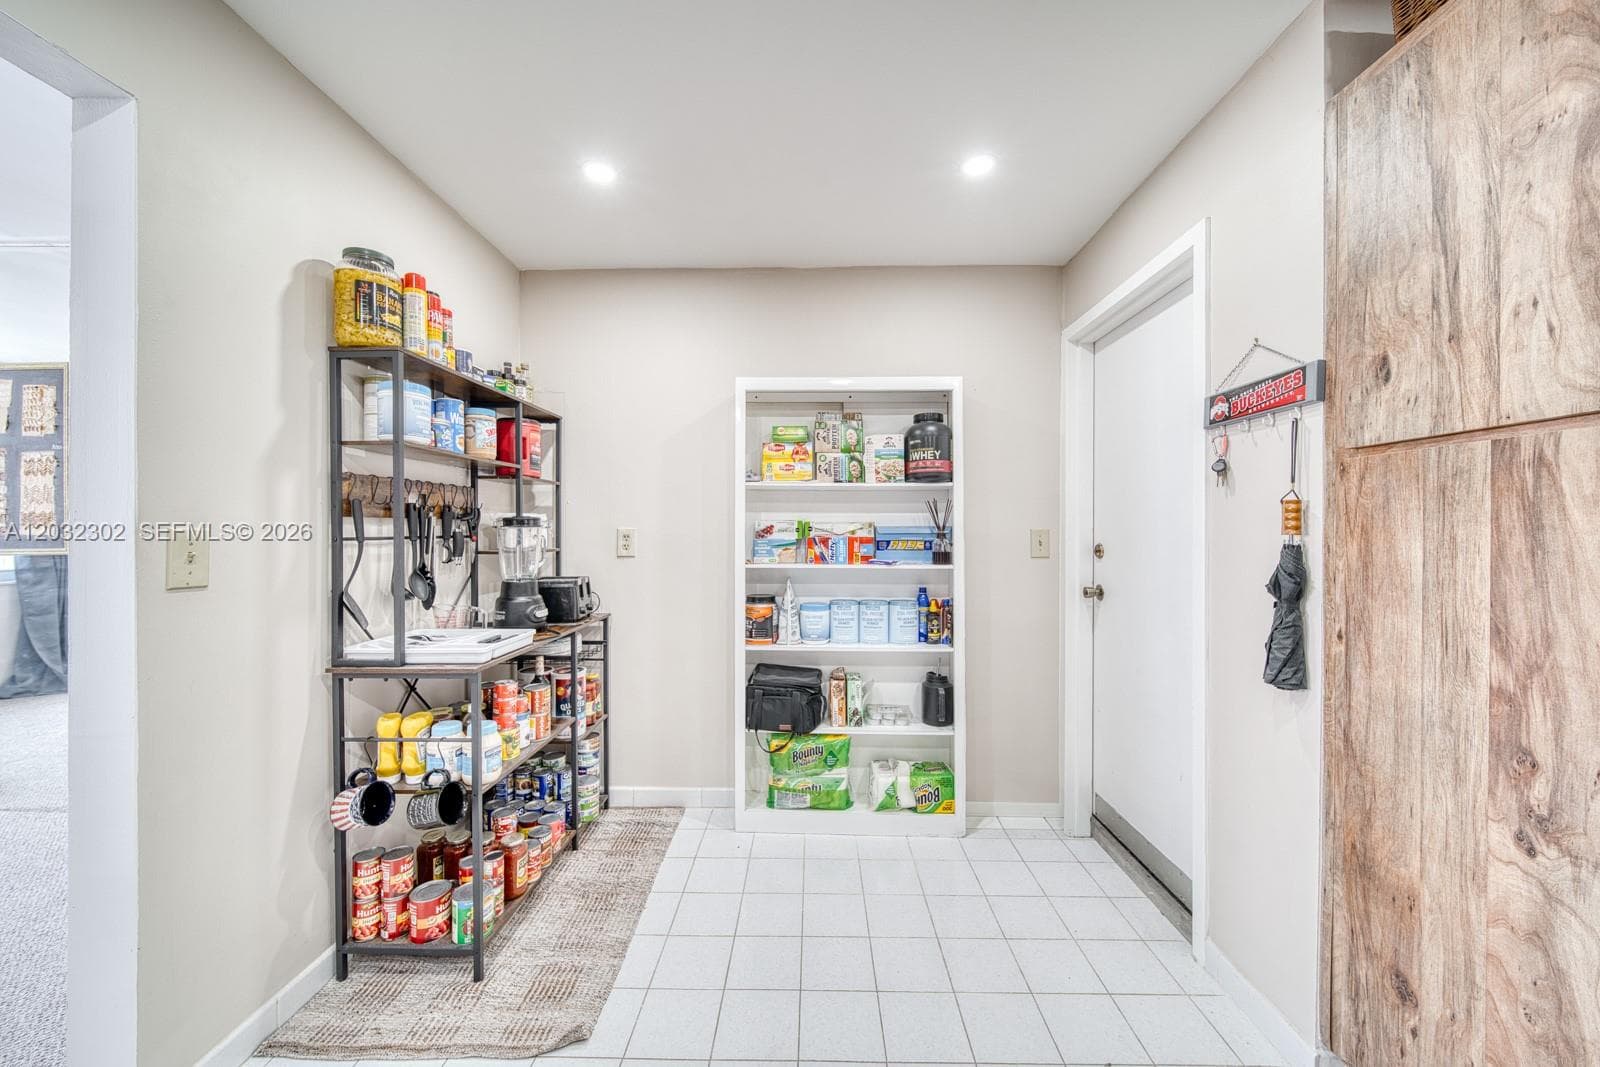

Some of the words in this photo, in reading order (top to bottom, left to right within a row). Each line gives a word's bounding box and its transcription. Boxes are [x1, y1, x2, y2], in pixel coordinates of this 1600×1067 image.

[1230, 370, 1303, 416] BUCKEYES
[912, 450, 941, 461] WHEY
[792, 745, 823, 763] Bounty
